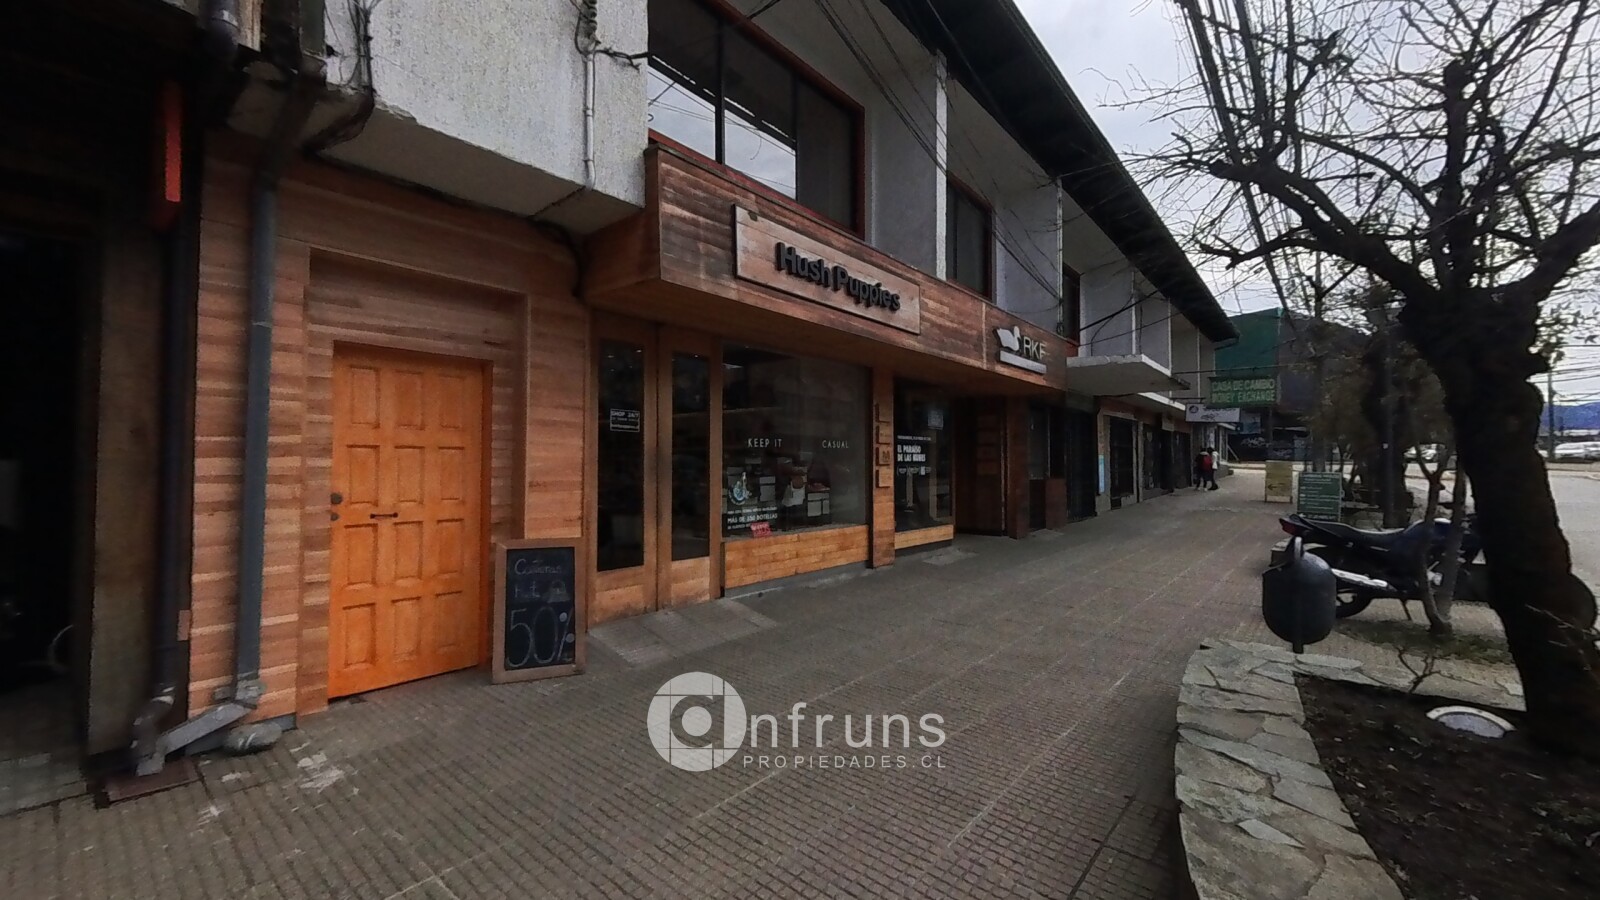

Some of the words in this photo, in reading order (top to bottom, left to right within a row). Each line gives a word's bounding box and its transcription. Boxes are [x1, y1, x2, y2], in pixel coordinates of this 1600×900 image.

[775, 242, 831, 288] Hush
[832, 265, 900, 311] Puppies
[1212, 381, 1232, 392] CASA
[1232, 380, 1243, 391] DE
[1244, 378, 1275, 390] CAMBIO
[1238, 389, 1275, 402] EXCHANGE
[748, 438, 769, 448] KEEP
[774, 438, 782, 447] IT
[822, 440, 849, 448] CASUAL
[897, 444, 902, 453] EL
[897, 453, 903, 462] DE
[904, 453, 912, 462] LAS
[757, 512, 778, 521] BOTELLAS
